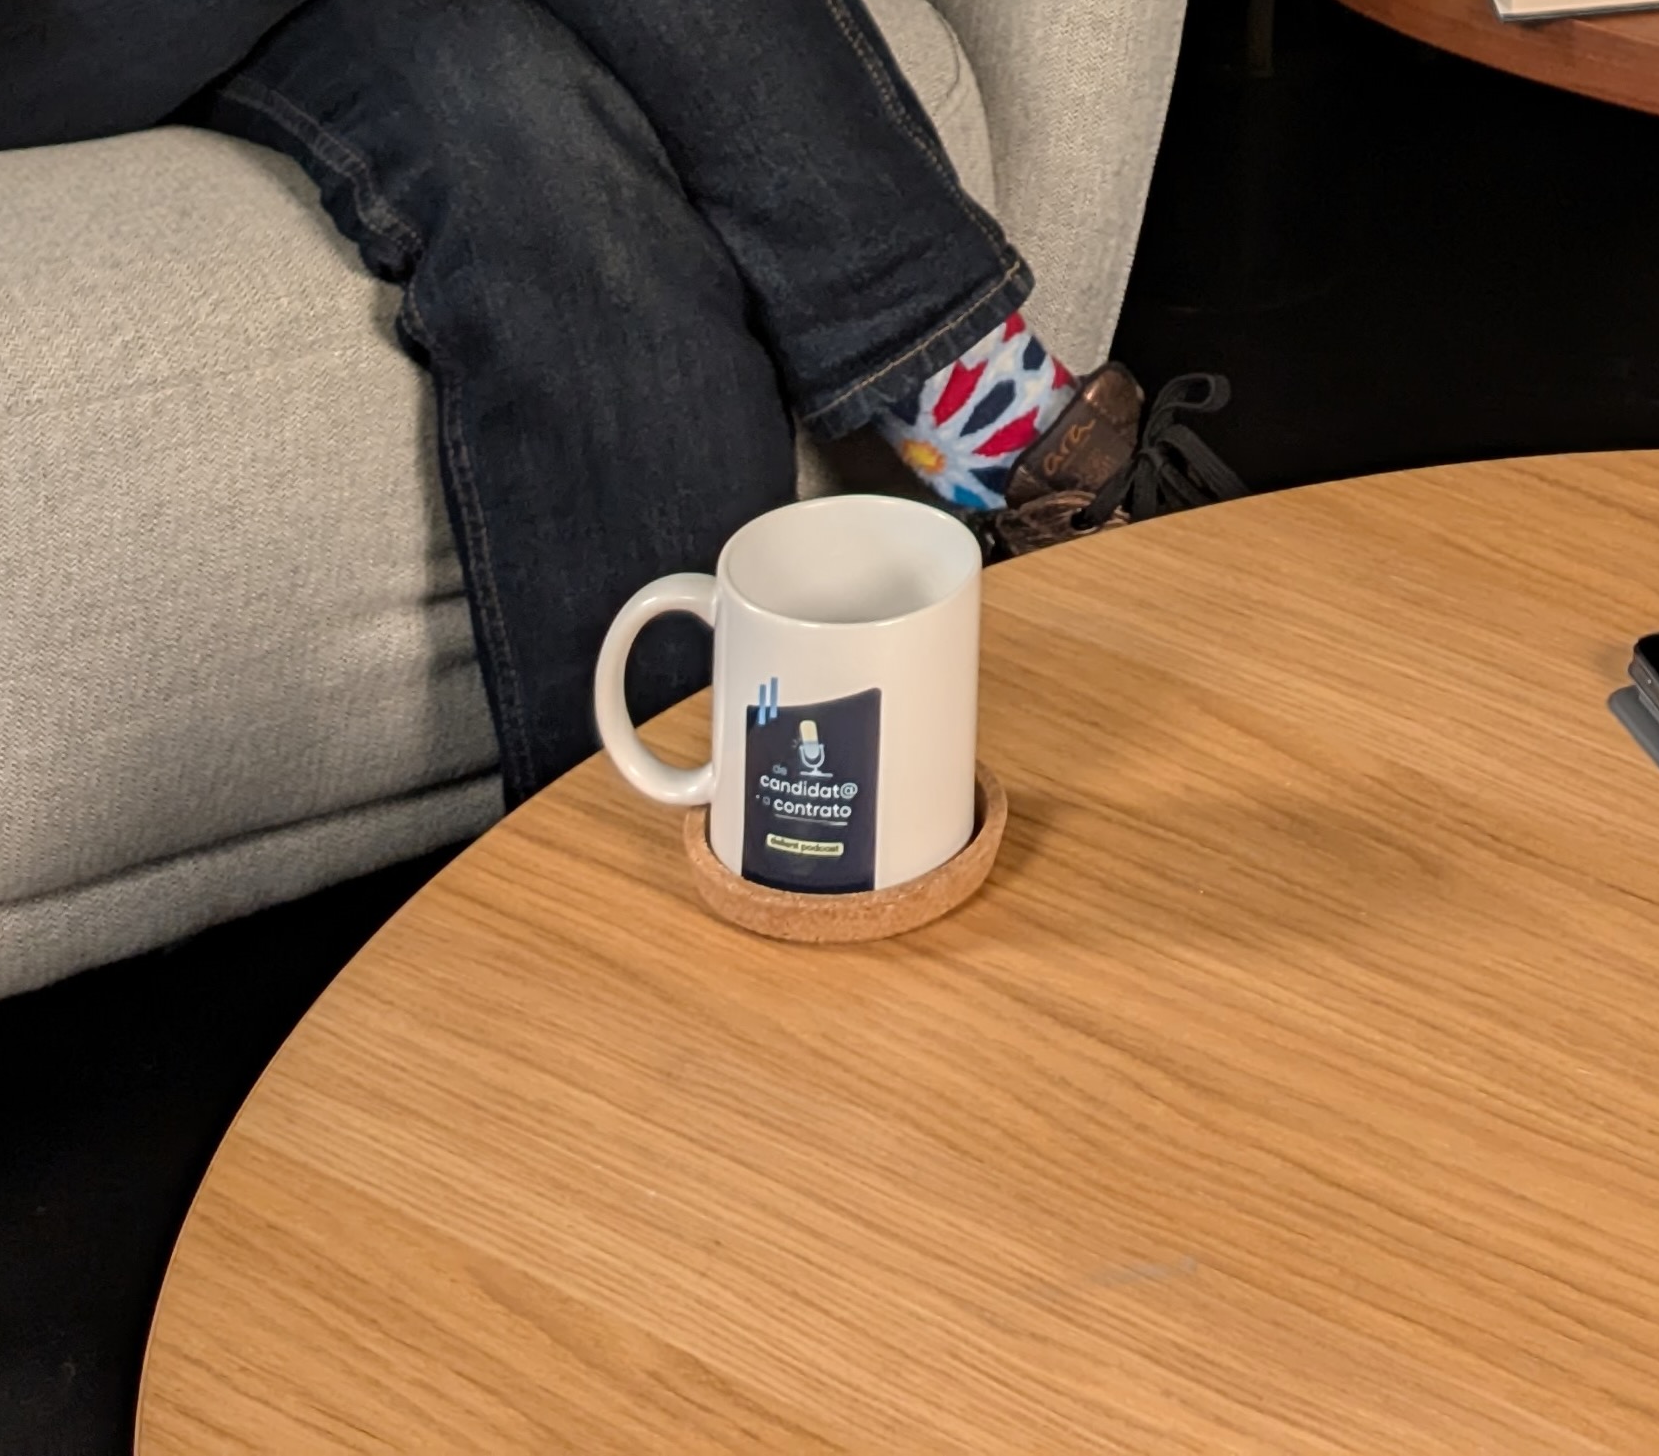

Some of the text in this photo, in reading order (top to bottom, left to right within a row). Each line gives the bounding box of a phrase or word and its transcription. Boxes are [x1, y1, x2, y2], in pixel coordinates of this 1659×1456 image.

[1043, 417, 1097, 476] ara
[760, 774, 859, 800] candidat@
[773, 798, 852, 818] contrato
